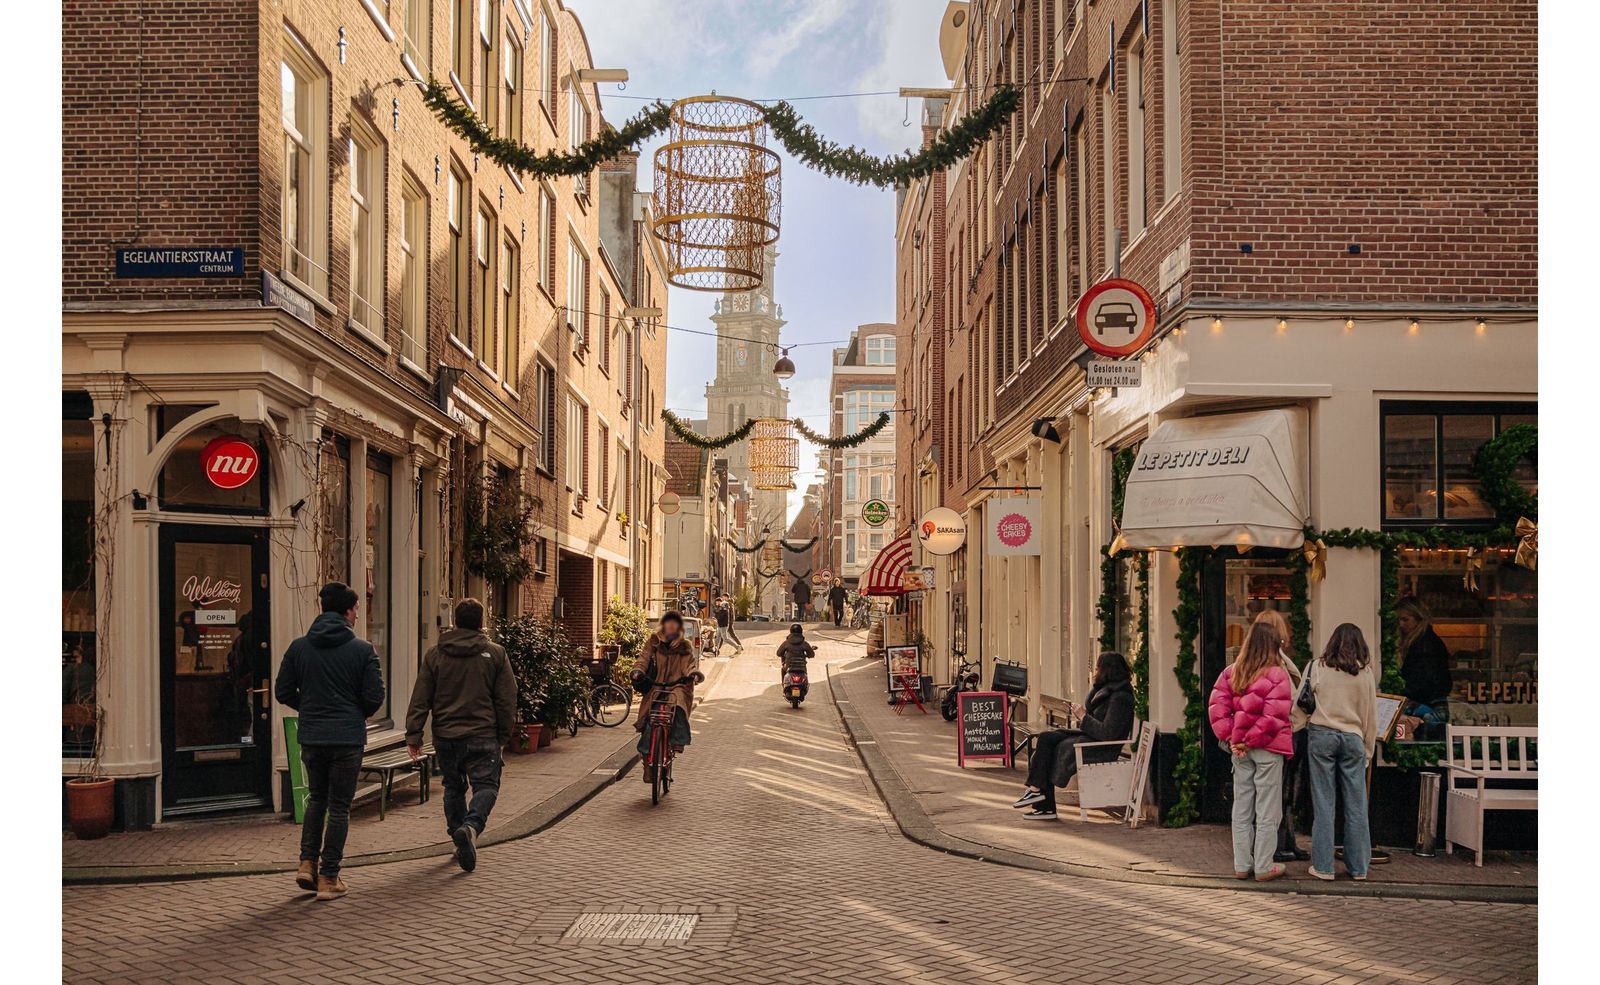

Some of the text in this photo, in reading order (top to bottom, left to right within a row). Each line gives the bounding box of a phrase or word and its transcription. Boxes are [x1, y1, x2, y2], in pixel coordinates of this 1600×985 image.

[123, 251, 233, 263] EGELANTIERSSTRAAT
[1093, 364, 1122, 373] Gesloten
[1104, 377, 1112, 385] tot
[1138, 446, 1250, 470] LE PETIT DELI
[211, 455, 254, 474] nu
[1001, 521, 1028, 531] CHEESY
[1003, 530, 1026, 538] CAKES
[182, 575, 242, 606] Welkom
[1467, 682, 1486, 702] LE
[972, 701, 995, 713] BEST
[963, 712, 1003, 721] CHEESECAKE
[964, 726, 1001, 736] Amsterdam
